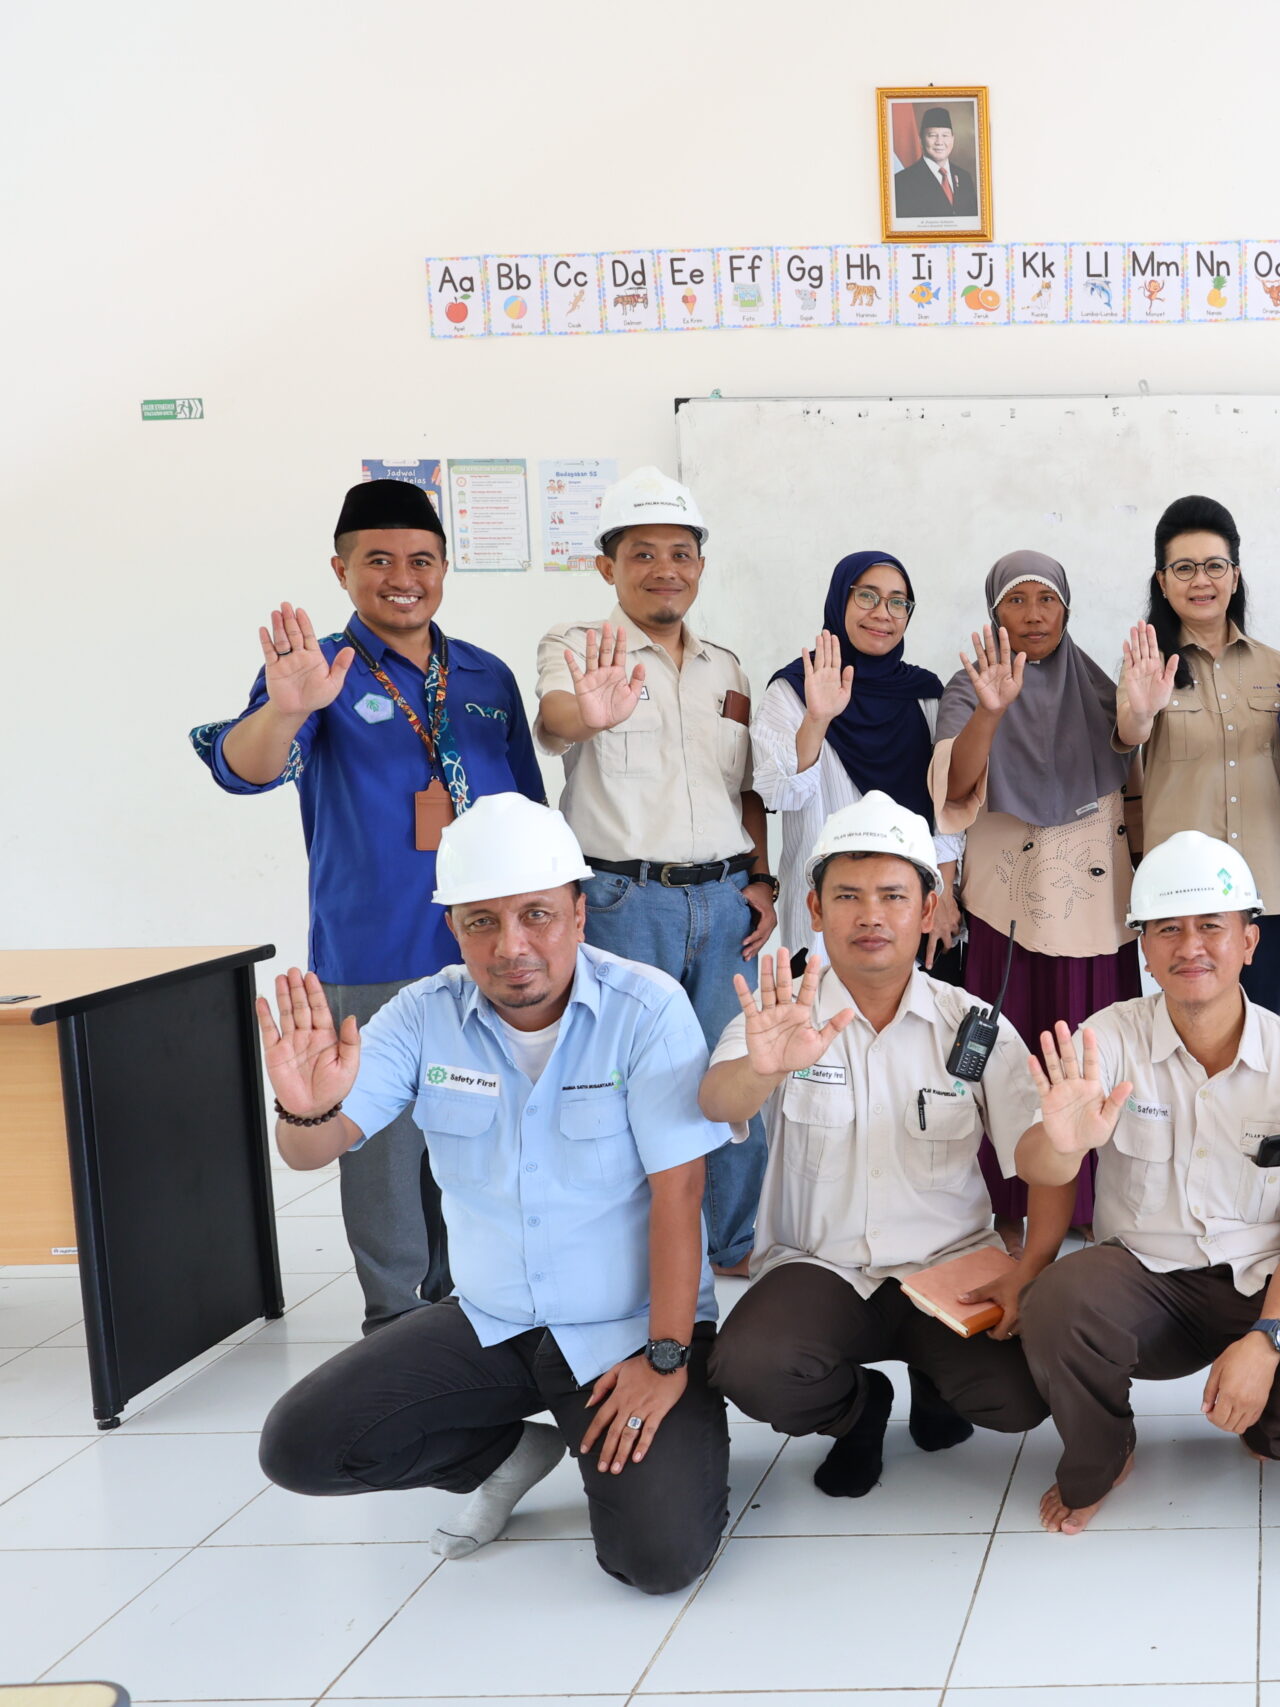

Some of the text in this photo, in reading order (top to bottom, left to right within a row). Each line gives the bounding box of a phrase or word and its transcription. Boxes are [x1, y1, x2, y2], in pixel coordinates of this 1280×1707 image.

[496, 262, 532, 291] Bb
[553, 260, 589, 288] Cc
[611, 258, 647, 288] Dd
[669, 257, 705, 286] Ee
[728, 254, 763, 283] Ff
[786, 254, 824, 289] Gg
[845, 253, 881, 281] Hh
[911, 253, 933, 280] Ii
[966, 252, 994, 287] Jj
[1022, 251, 1055, 278] Kk
[1085, 251, 1109, 278] Ll
[1131, 250, 1180, 277] Mm
[1196, 250, 1231, 277] Nn
[438, 265, 475, 294] Aa
[387, 469, 416, 477] Jadwal
[450, 1073, 497, 1088] Safety First
[812, 1069, 832, 1079] Safety
[1137, 1104, 1158, 1117] Safety
